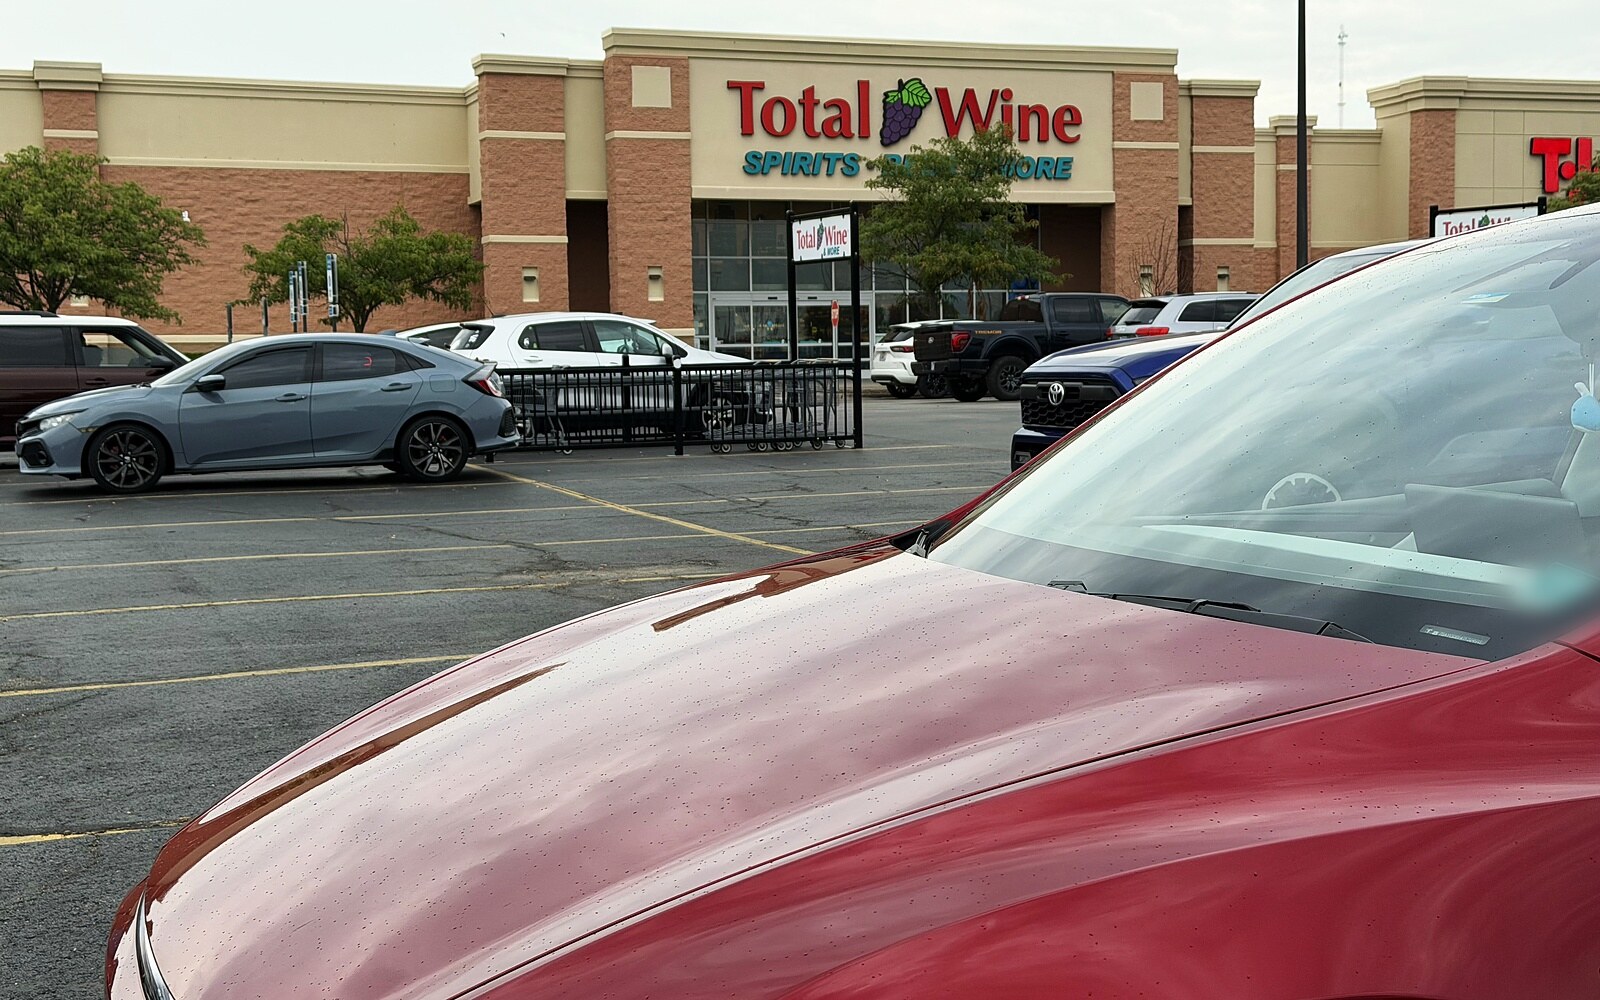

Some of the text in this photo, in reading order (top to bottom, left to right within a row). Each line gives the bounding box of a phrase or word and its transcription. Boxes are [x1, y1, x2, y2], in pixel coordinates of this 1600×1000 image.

[727, 79, 1083, 143] Total Wine
[742, 150, 860, 177] SPIRITS
[1001, 155, 1074, 180] ORE
[797, 224, 848, 250] Total Wine
[827, 246, 840, 256] MORE
